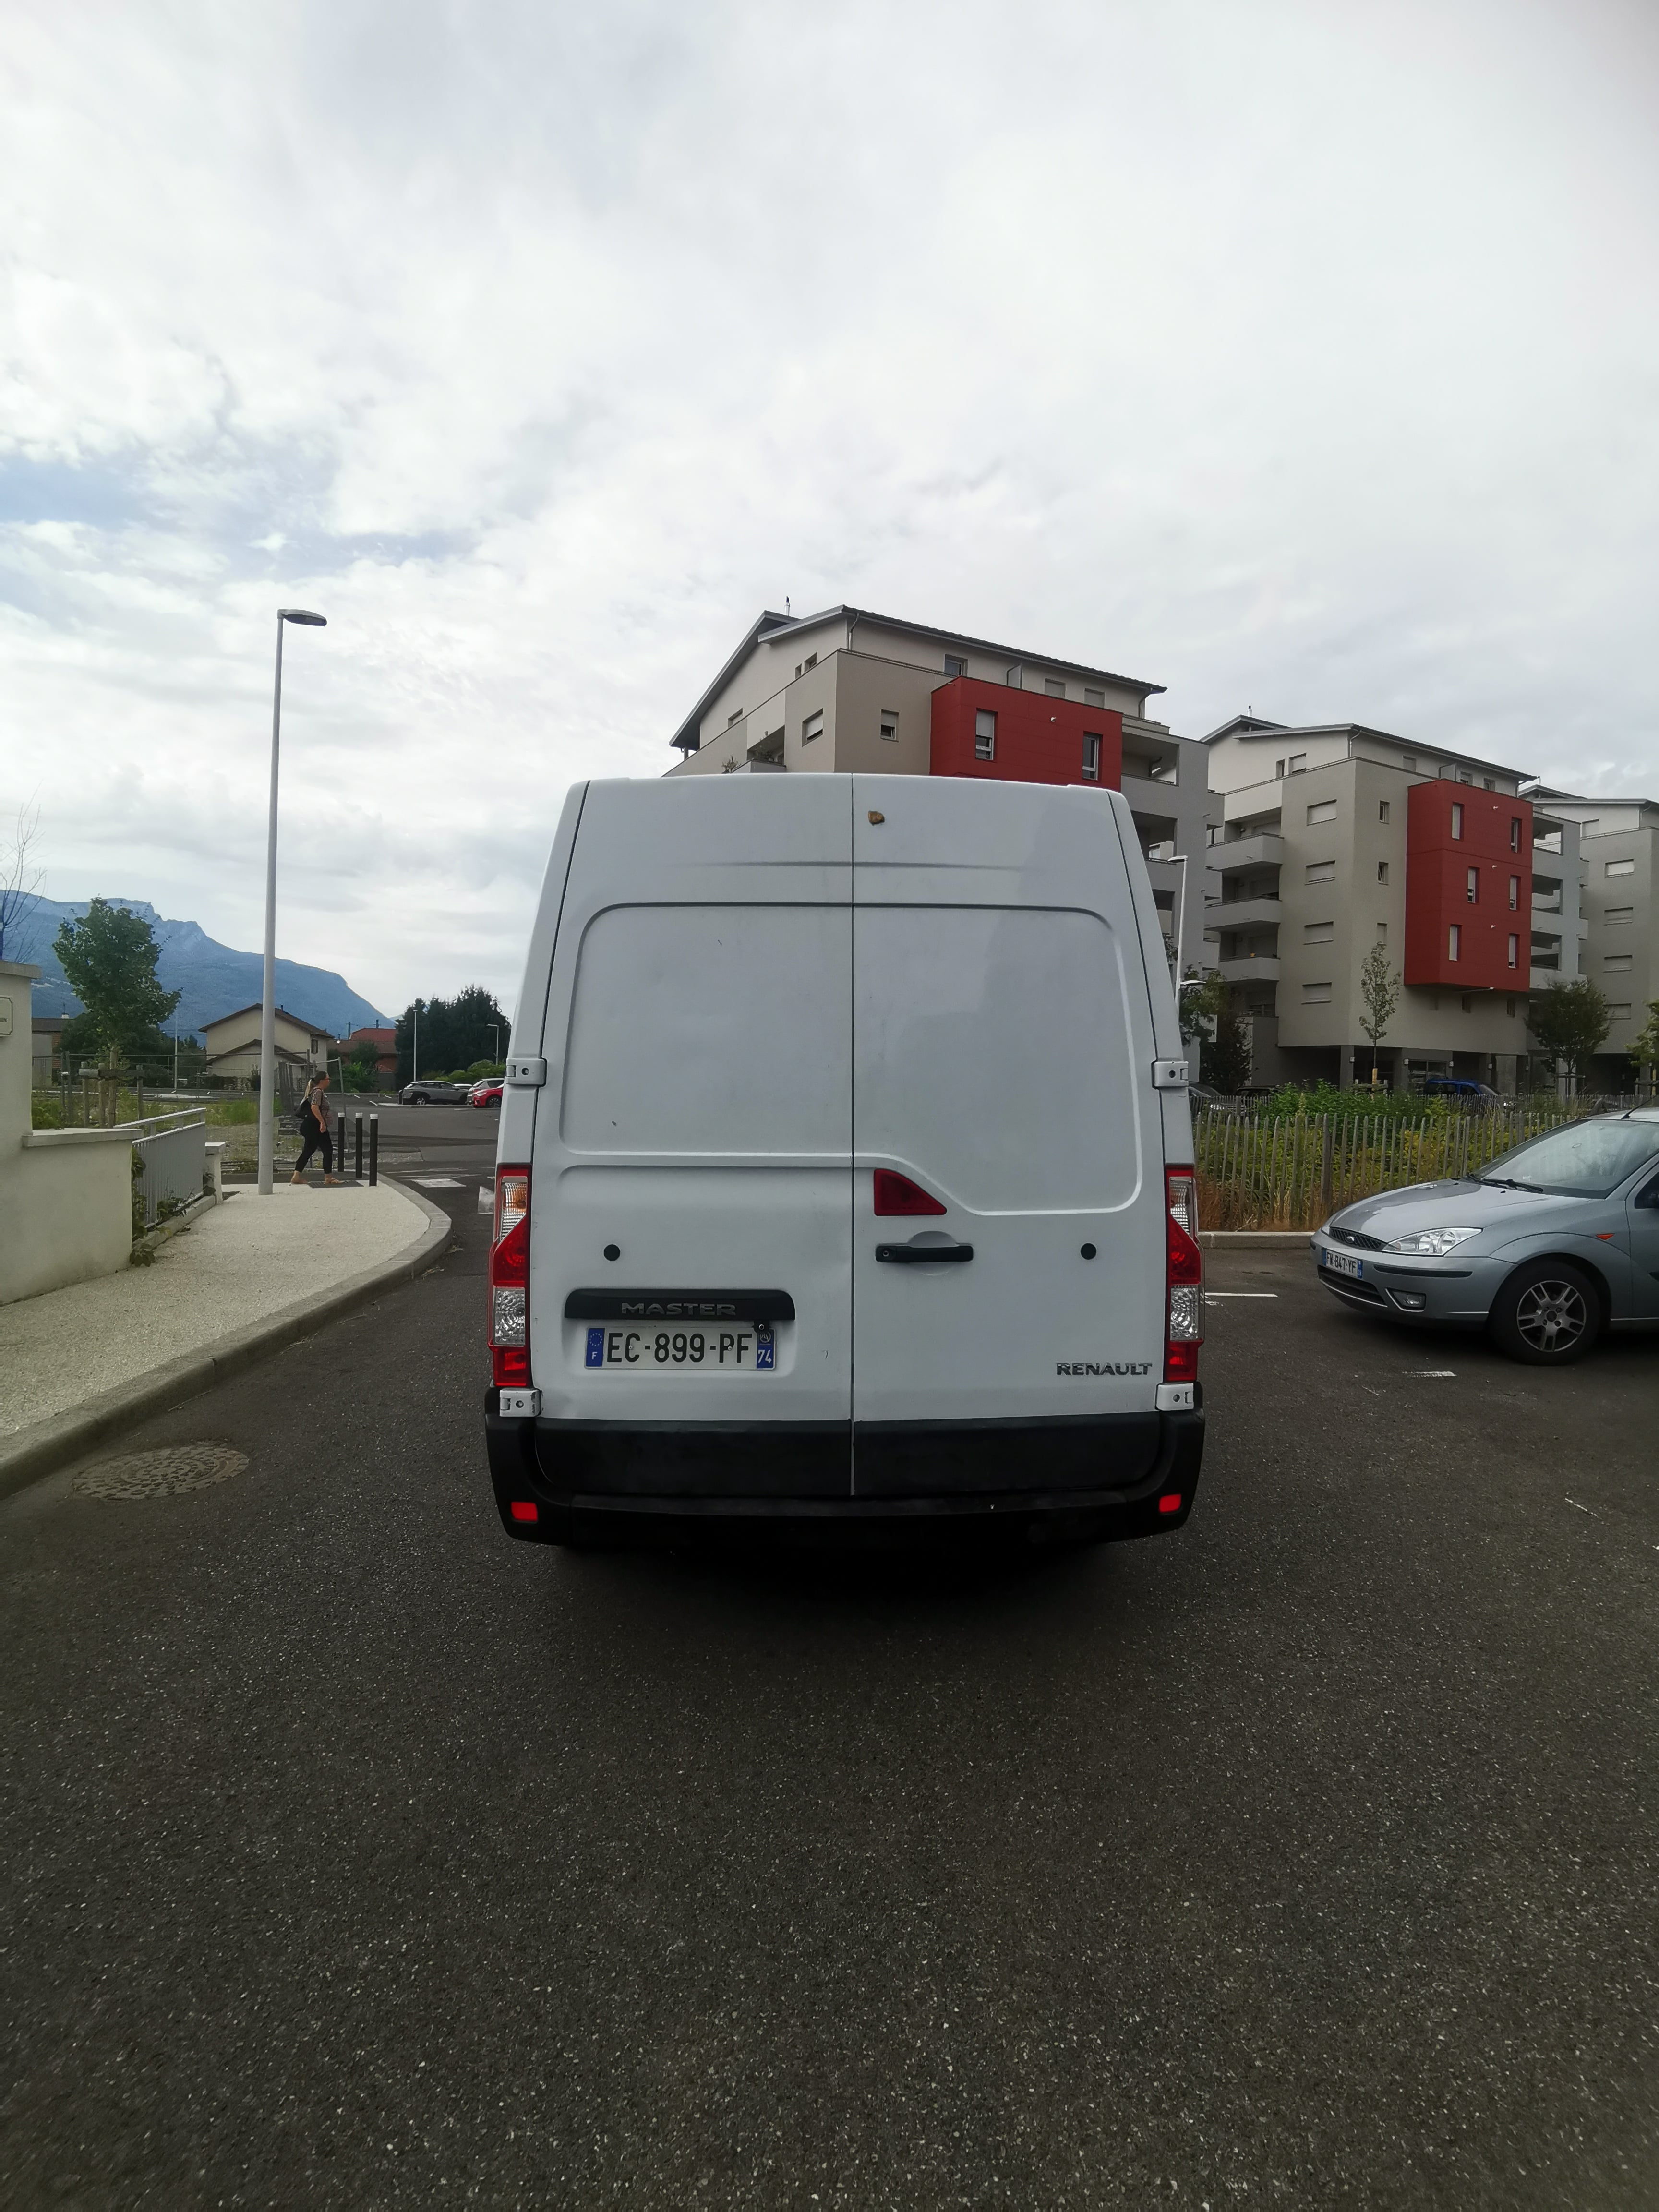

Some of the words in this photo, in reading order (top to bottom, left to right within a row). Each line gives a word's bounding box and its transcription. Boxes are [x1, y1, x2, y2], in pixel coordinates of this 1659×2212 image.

[622, 1302, 736, 1316] MASTER
[591, 1351, 598, 1360] F
[607, 1333, 753, 1363] EC-899-PF
[757, 1349, 772, 1364] 74
[1056, 1362, 1153, 1375] RENAULT
